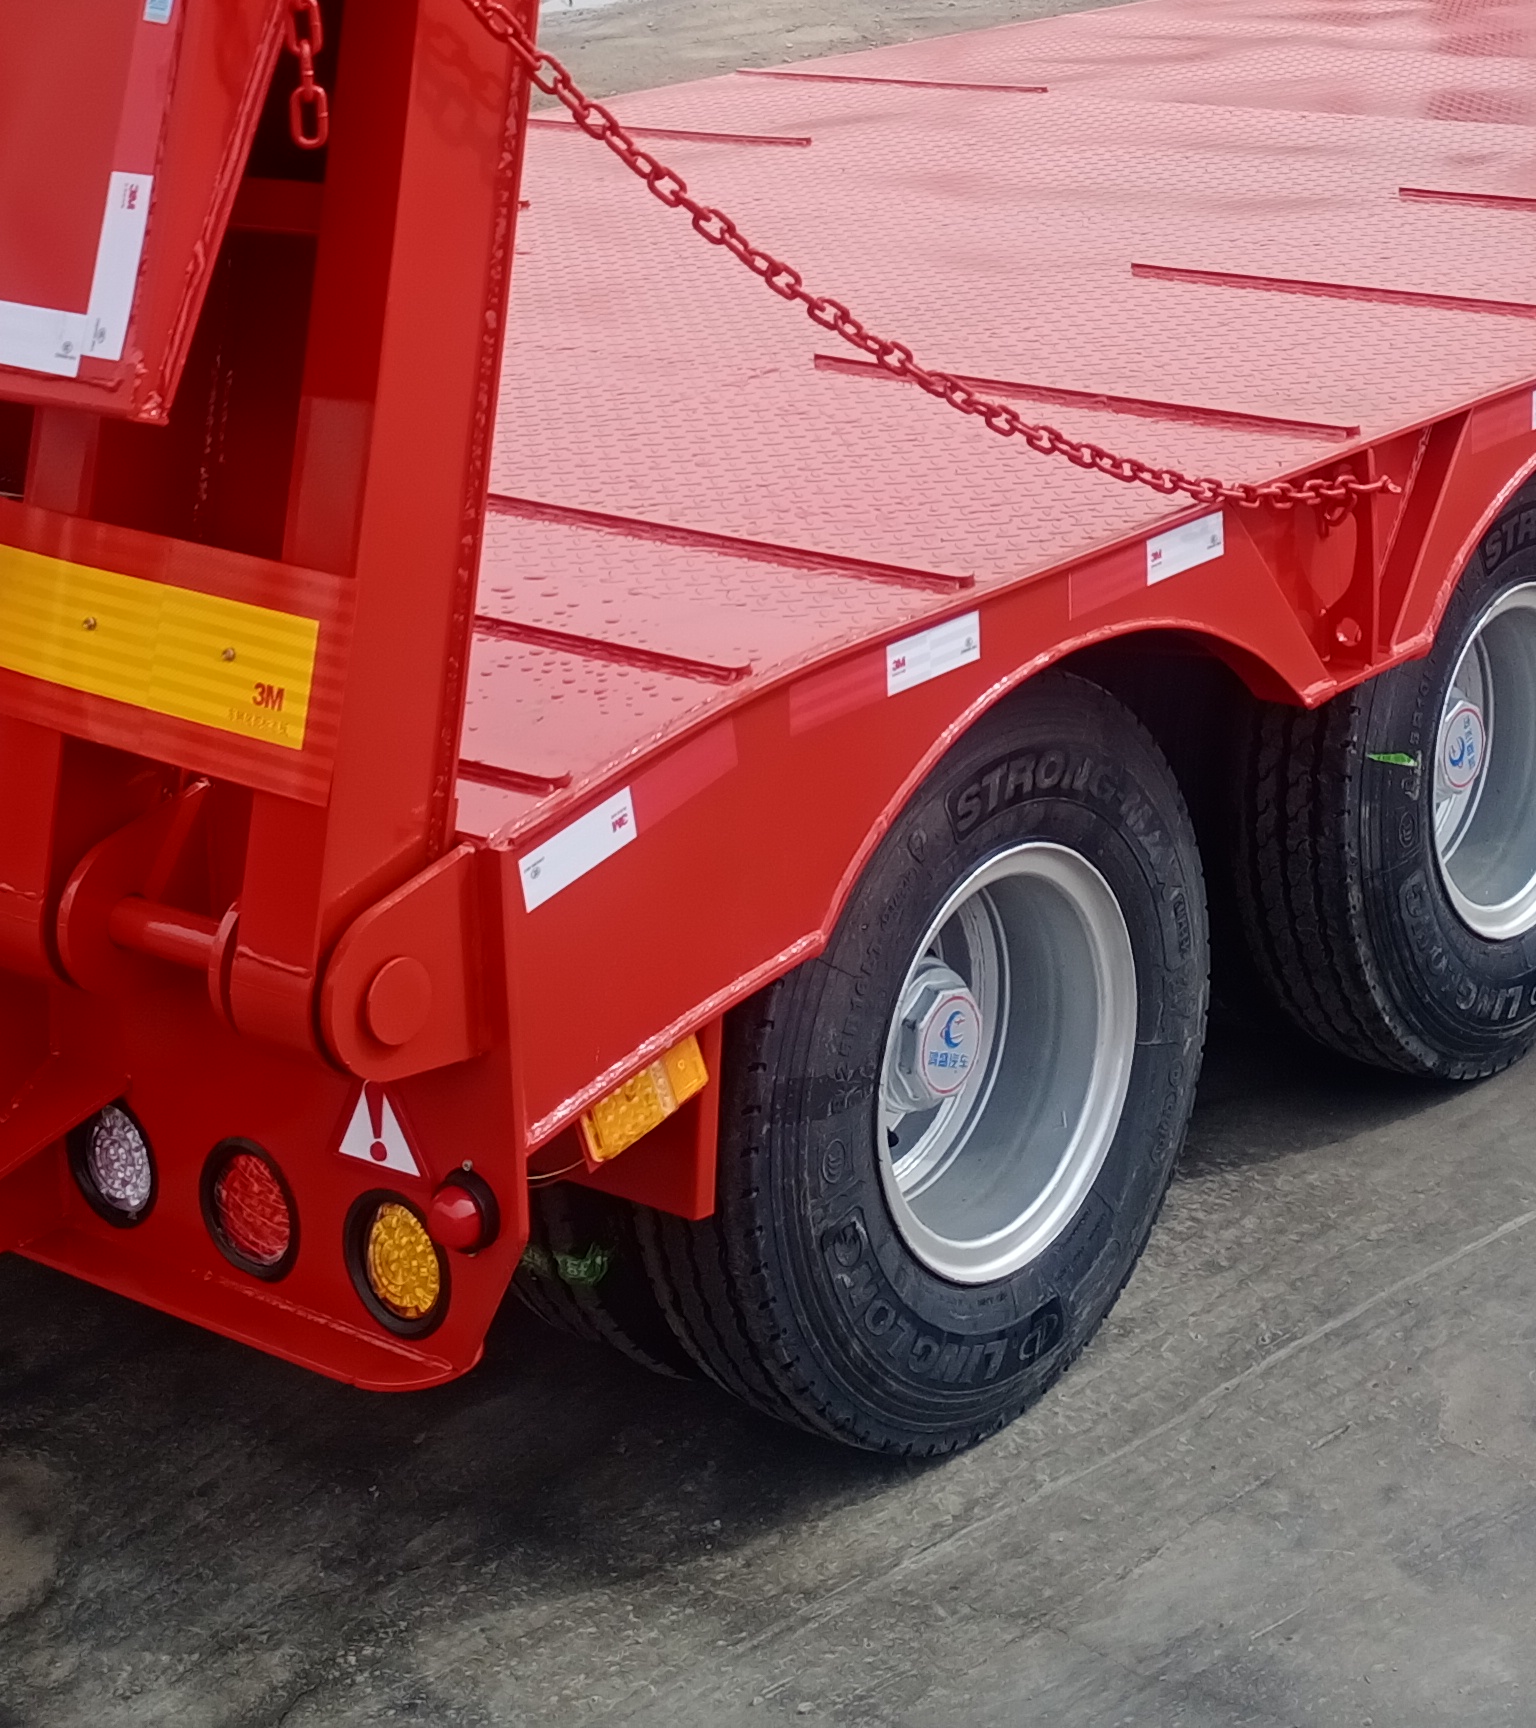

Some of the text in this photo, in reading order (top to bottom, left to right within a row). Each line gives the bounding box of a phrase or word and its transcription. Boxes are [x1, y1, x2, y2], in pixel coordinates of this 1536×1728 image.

[892, 655, 907, 672] 3M
[251, 682, 285, 713] 3M
[611, 815, 628, 833] 3M
[828, 1217, 1008, 1387] LINGLONG
